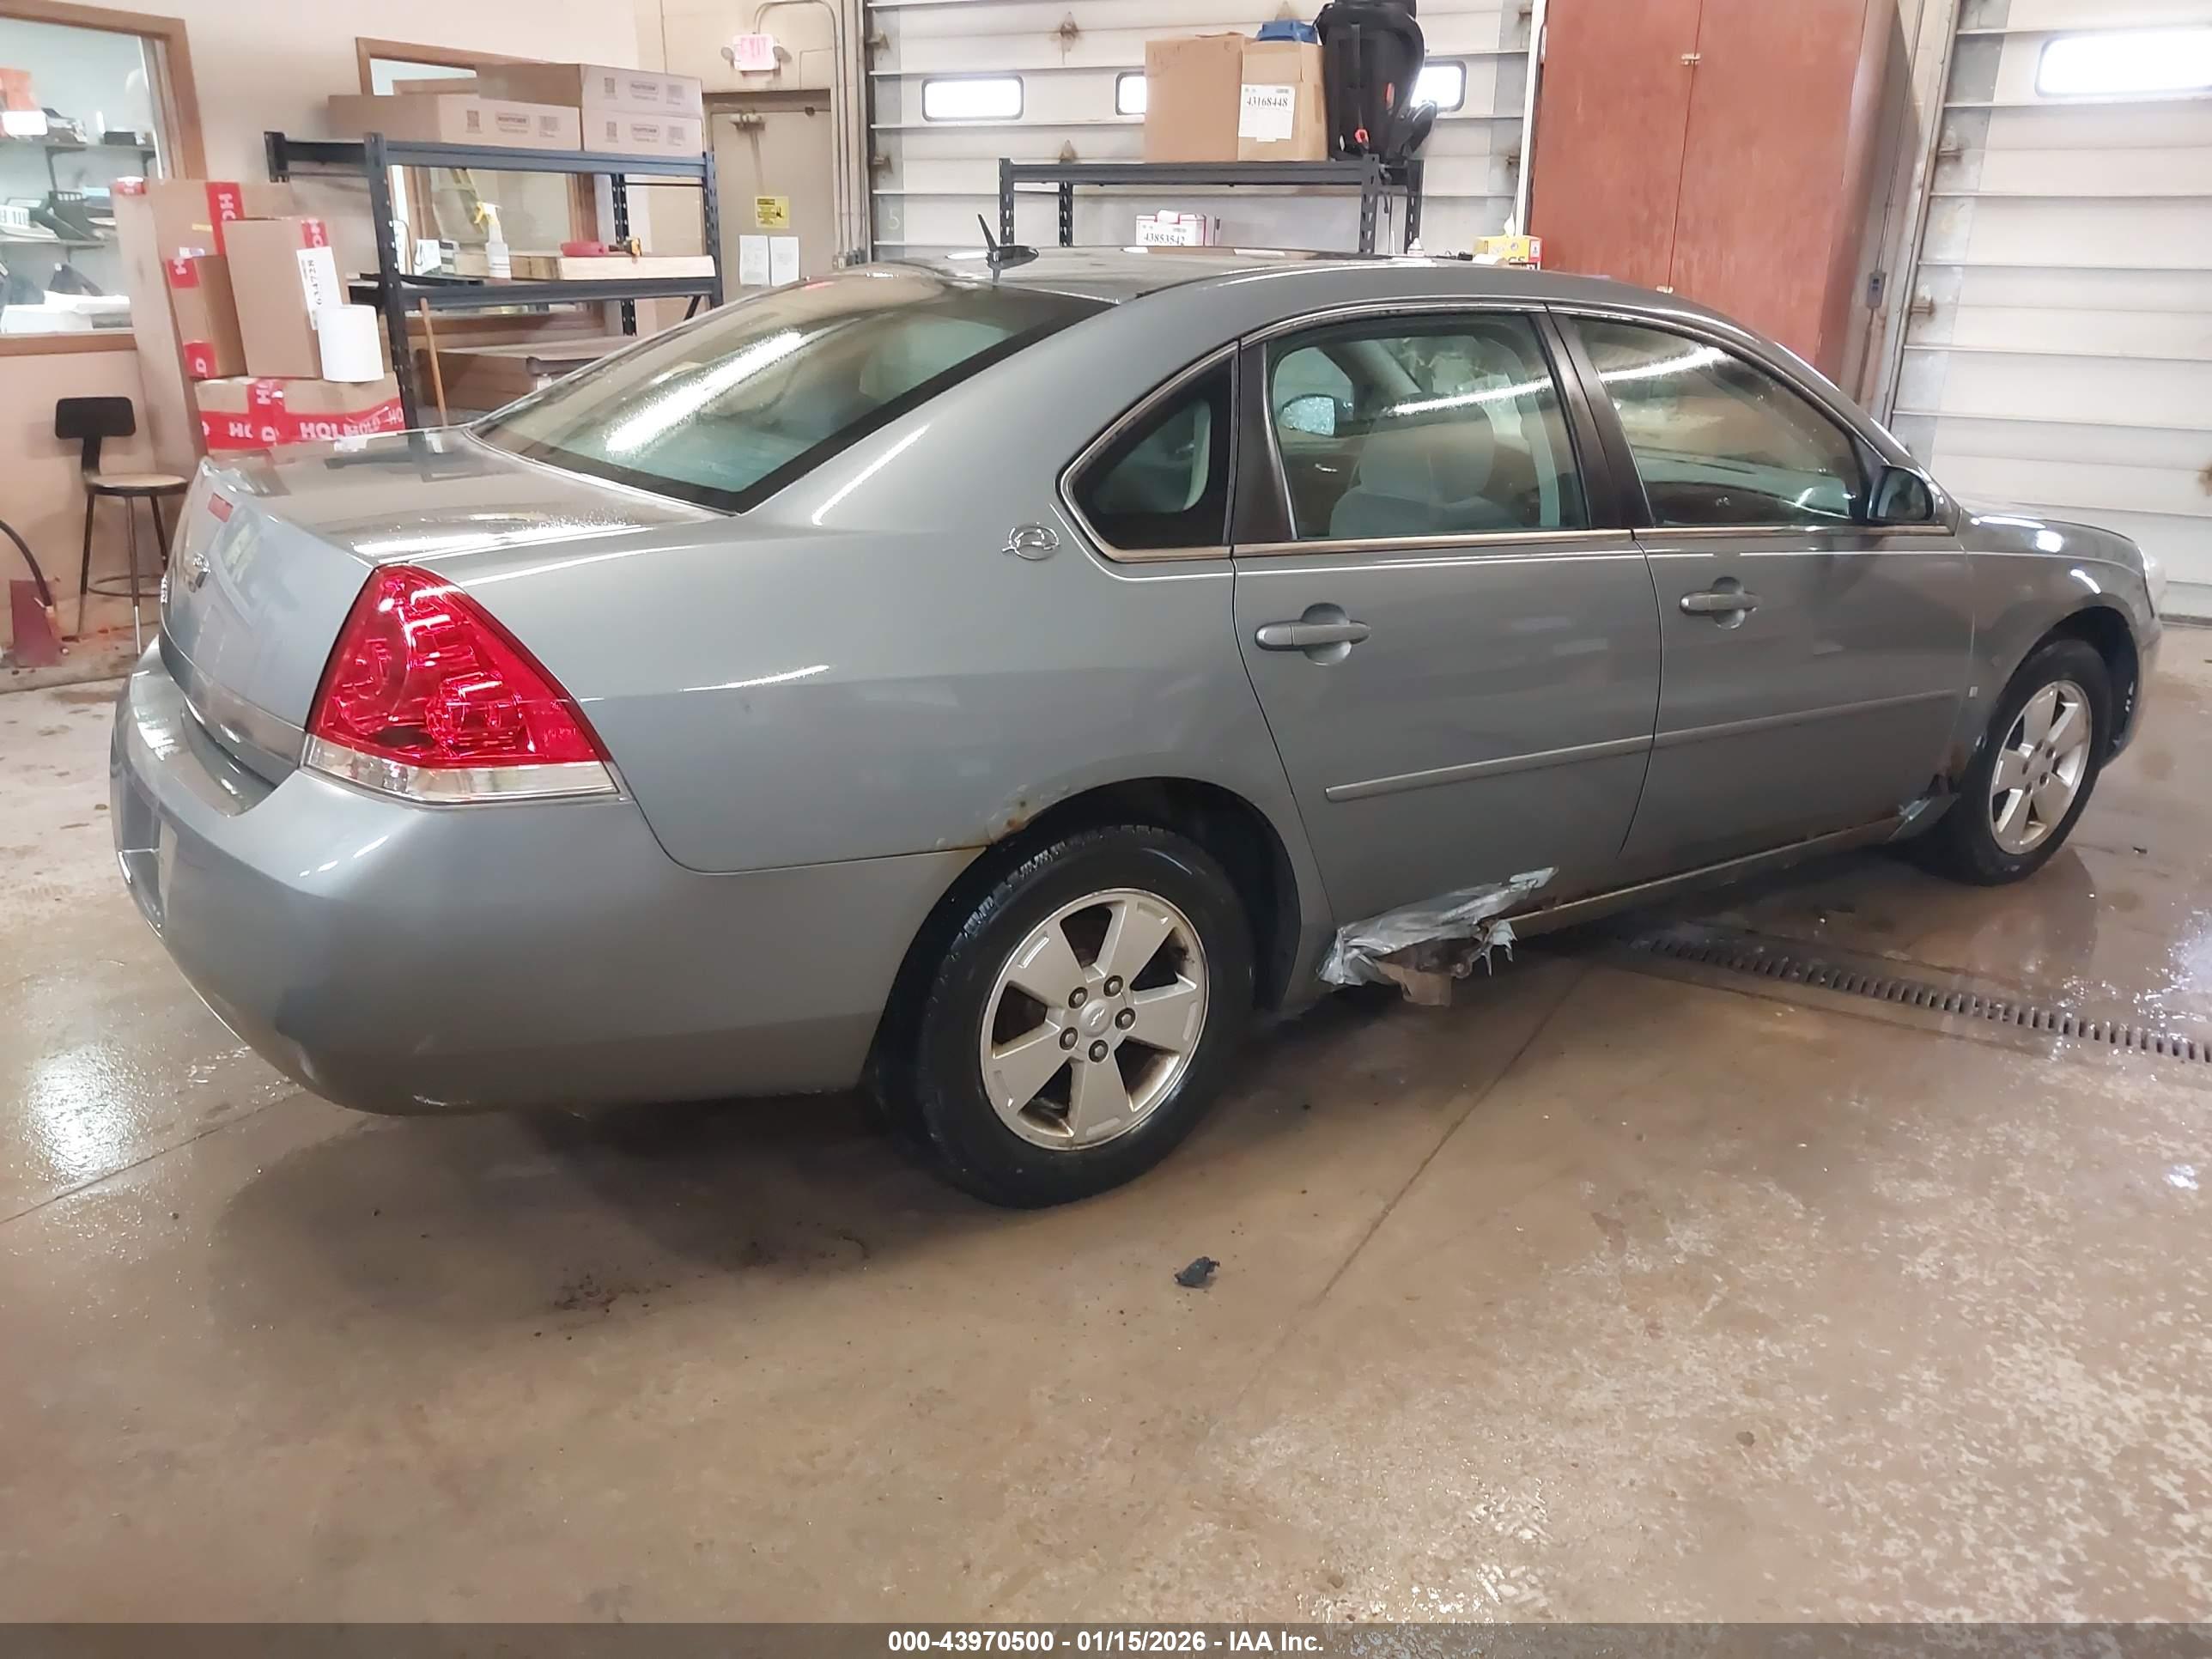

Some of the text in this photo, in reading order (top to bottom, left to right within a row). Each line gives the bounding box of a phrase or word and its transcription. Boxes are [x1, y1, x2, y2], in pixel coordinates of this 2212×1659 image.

[740, 37, 768, 58] EXIT
[1247, 95, 1288, 107] 43168448
[300, 422, 342, 441] HOL
